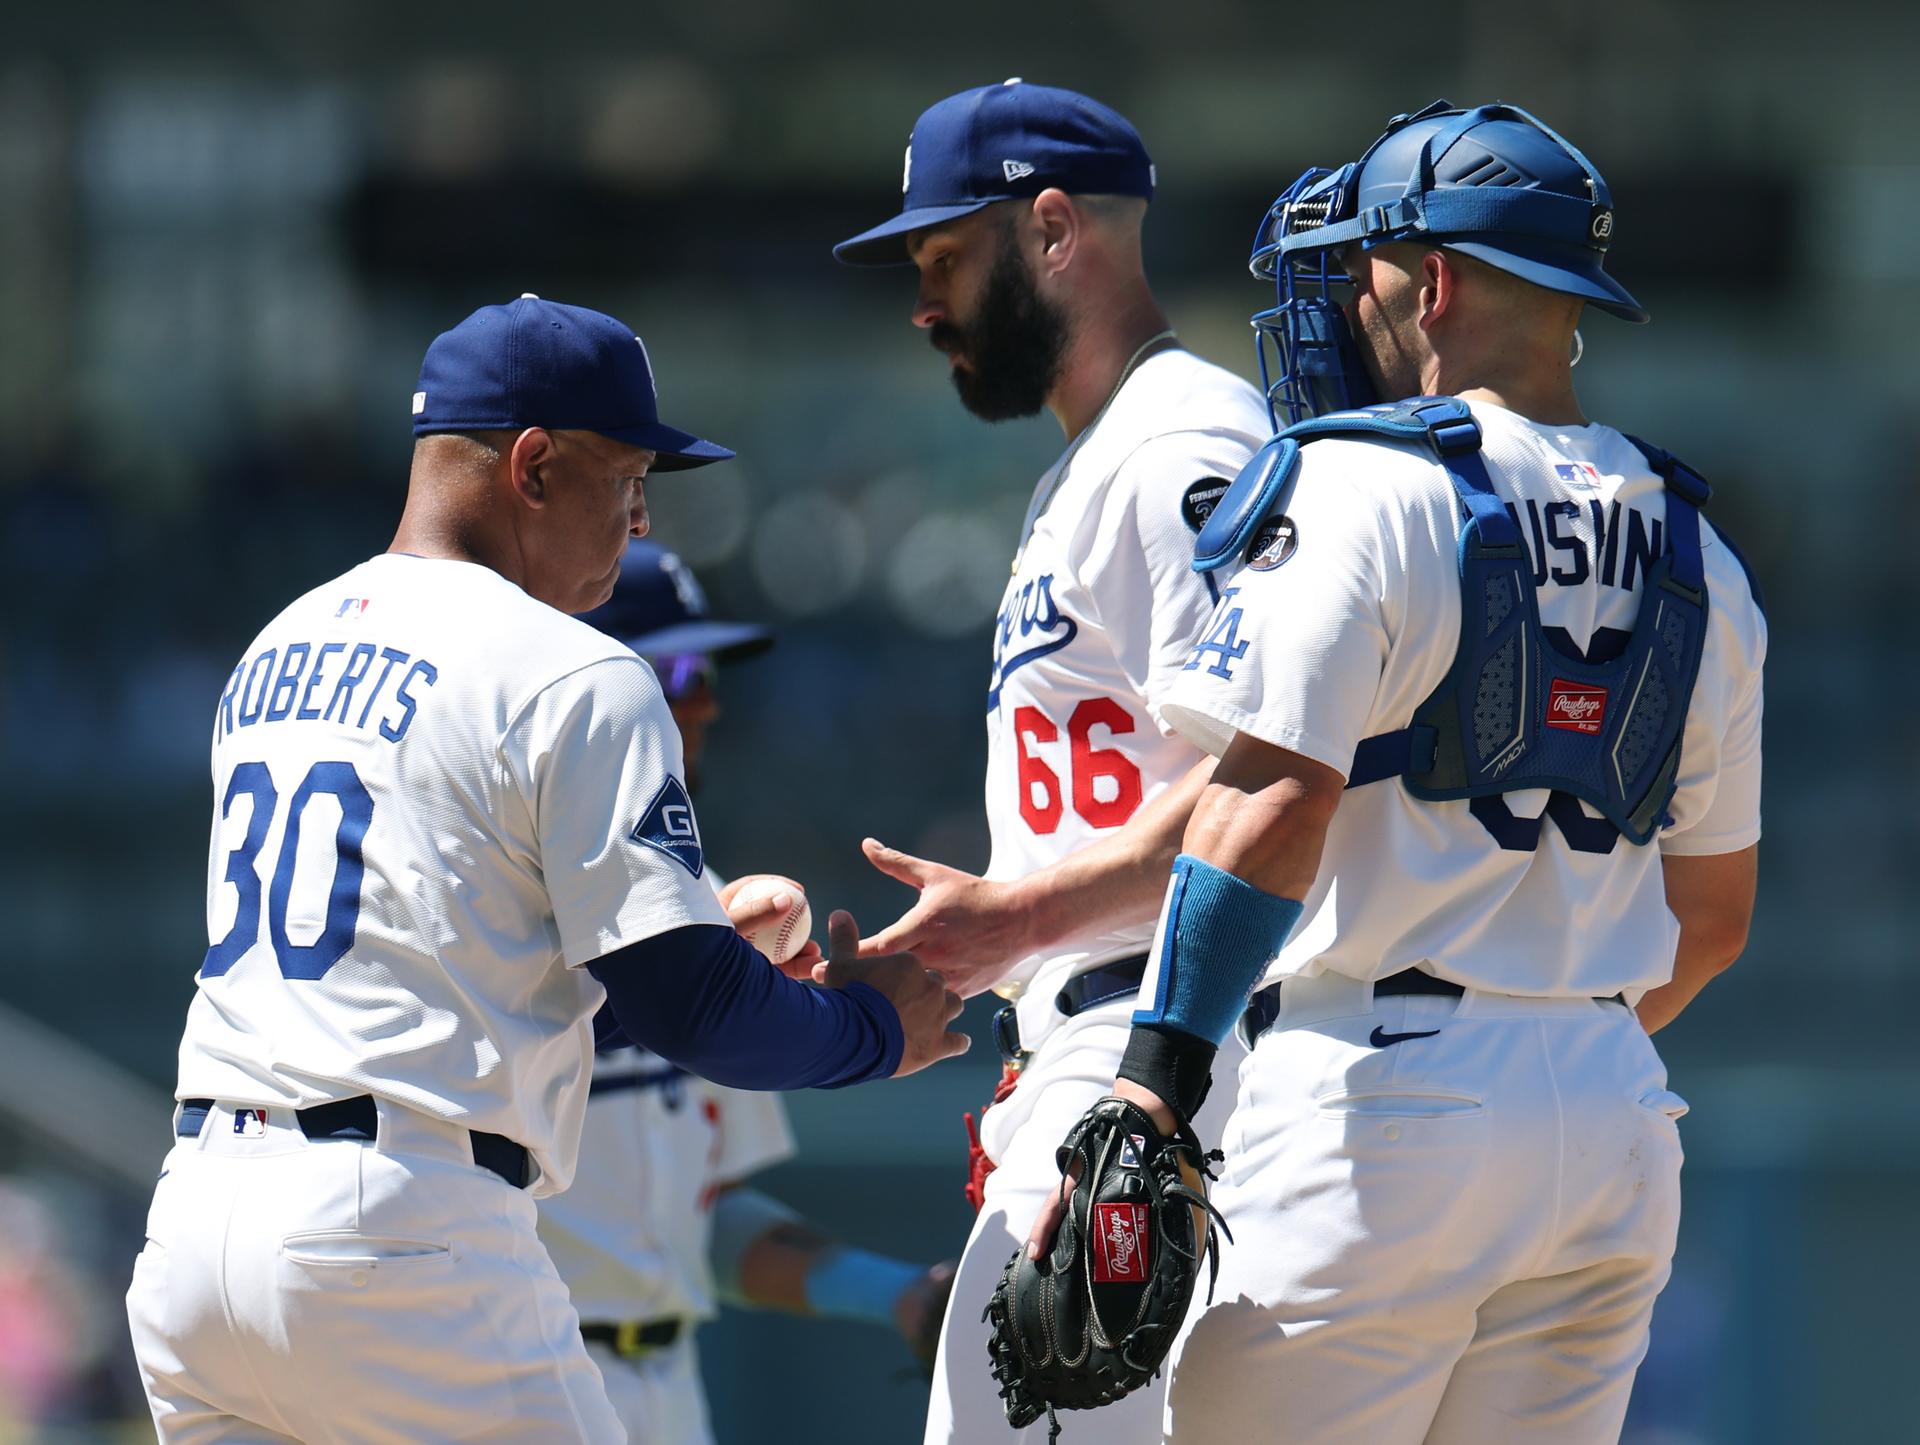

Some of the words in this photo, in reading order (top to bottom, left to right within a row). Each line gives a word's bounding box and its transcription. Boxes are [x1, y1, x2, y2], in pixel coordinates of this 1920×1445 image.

[1252, 536, 1287, 562] 34
[1183, 587, 1250, 680] LA
[218, 642, 438, 745] ROBERTS
[1554, 695, 1600, 717] Rawlings
[1014, 697, 1142, 834] 66
[661, 805, 693, 836] G
[200, 760, 374, 980] 30
[1107, 1210, 1130, 1274] Rawlings
